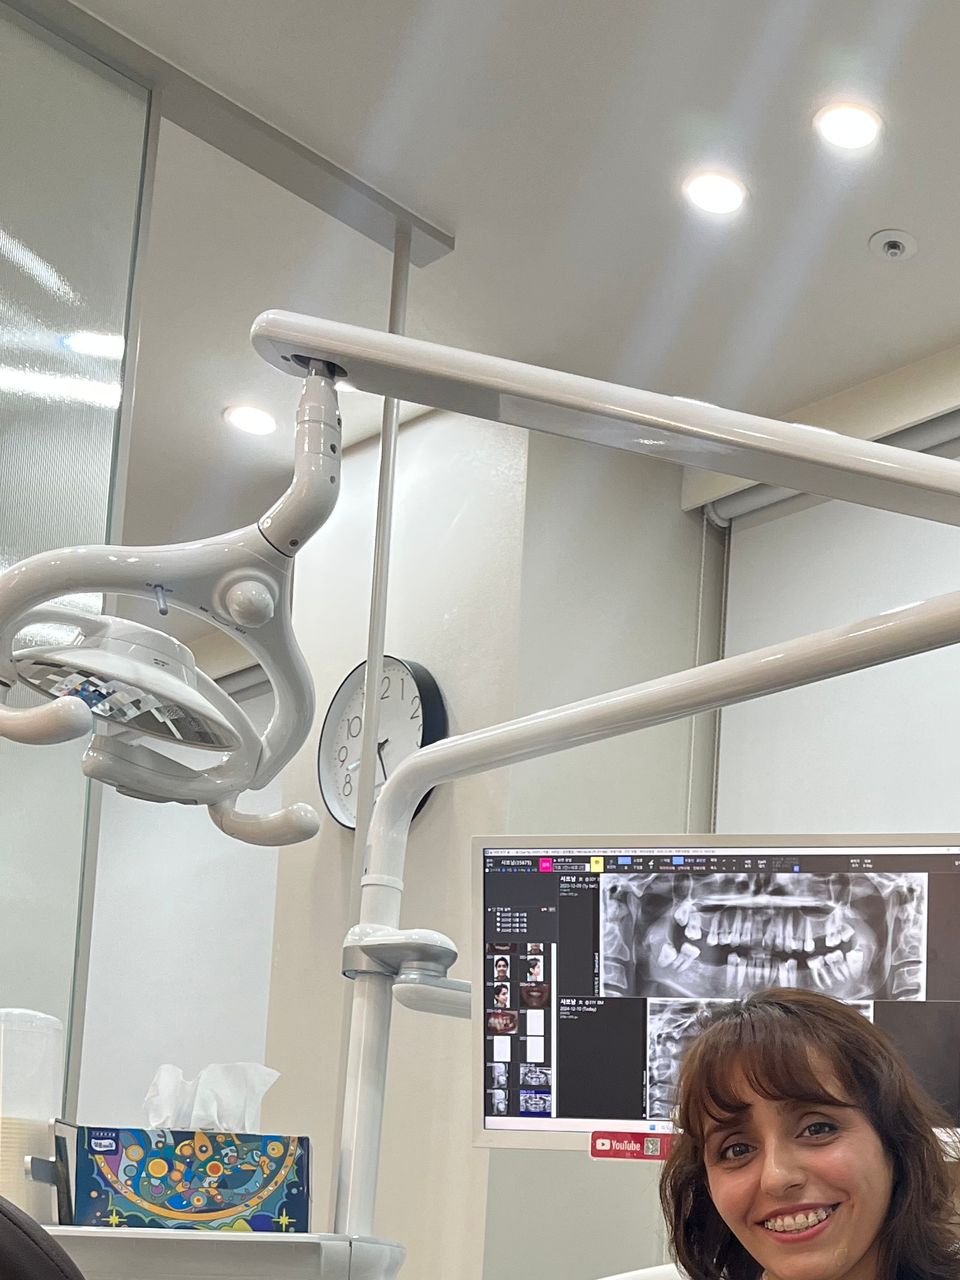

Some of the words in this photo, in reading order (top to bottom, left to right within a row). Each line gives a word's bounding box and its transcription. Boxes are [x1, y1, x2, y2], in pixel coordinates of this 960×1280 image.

[380, 676, 391, 700] 2
[400, 678, 405, 701] 1
[410, 695, 421, 720] 2
[346, 715, 362, 740] 10
[338, 745, 348, 769] 9
[342, 773, 352, 797] 8
[611, 1139, 641, 1152] YouTube
